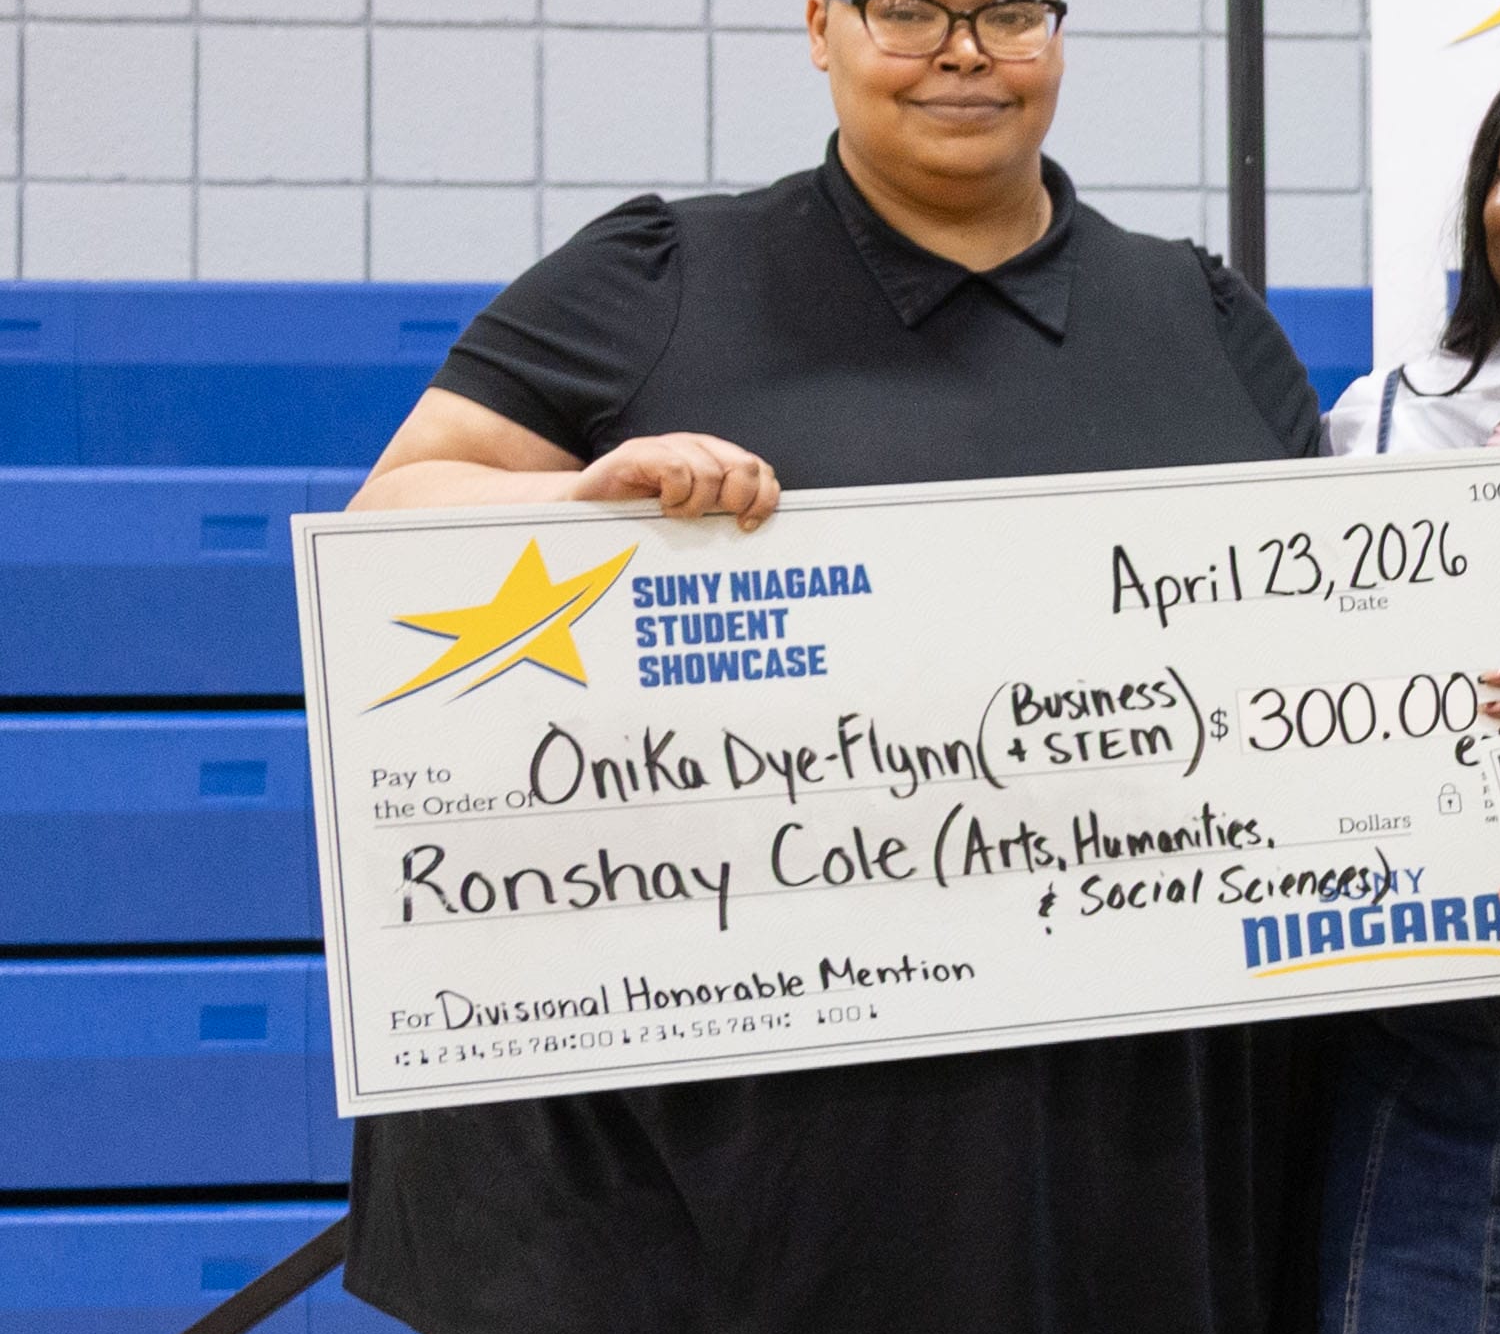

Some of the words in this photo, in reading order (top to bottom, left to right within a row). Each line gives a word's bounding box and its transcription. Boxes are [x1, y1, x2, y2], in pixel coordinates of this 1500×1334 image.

[632, 574, 722, 609] SUNY
[731, 564, 871, 602] NIAGARA
[1113, 545, 1243, 628] April
[1338, 593, 1388, 614] Date
[636, 608, 788, 648] STUDENT
[639, 645, 827, 688] SHOWCASE
[1248, 671, 1479, 752] 300.00
[1338, 813, 1411, 835] Dollars
[401, 843, 730, 931] Ronshay
[771, 821, 910, 888] Cole
[1079, 867, 1201, 917] Social
[437, 977, 609, 1031] Divisional
[624, 963, 805, 1016] Honorable
[819, 957, 975, 993] Mention
[390, 1009, 434, 1032] For
